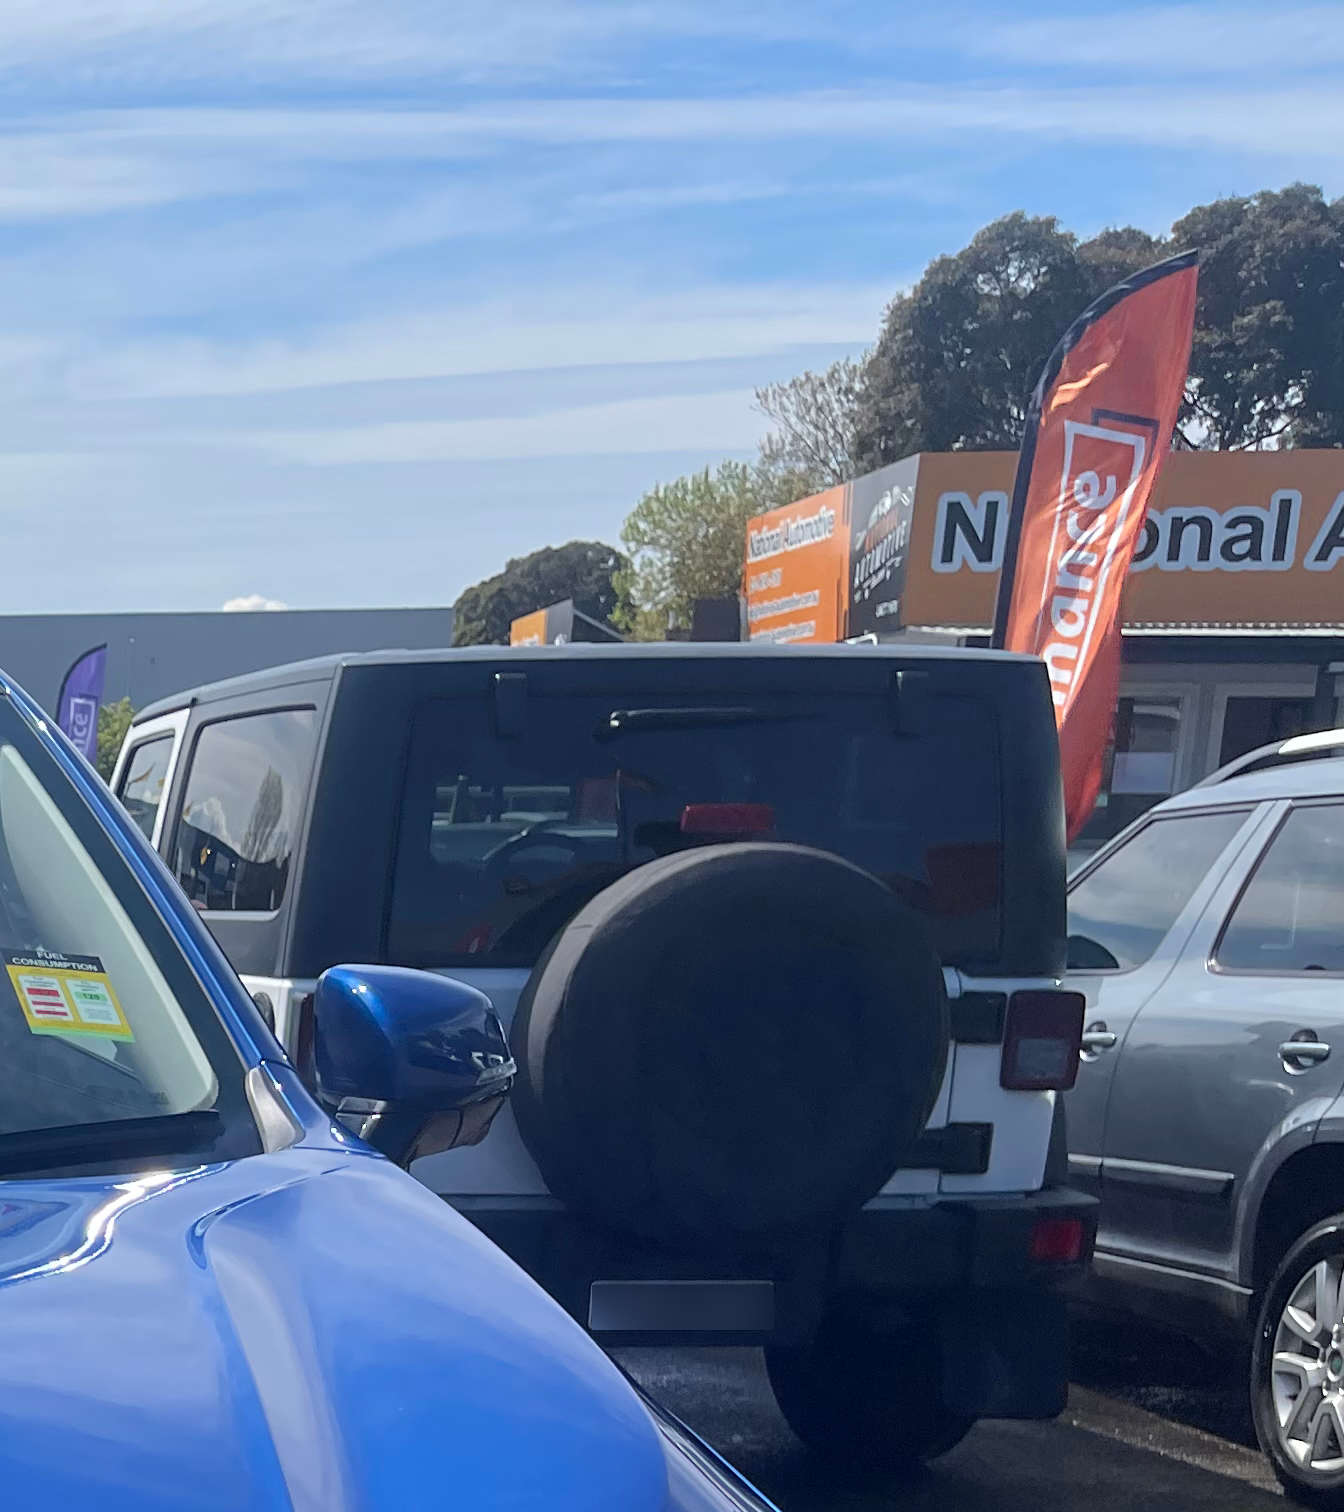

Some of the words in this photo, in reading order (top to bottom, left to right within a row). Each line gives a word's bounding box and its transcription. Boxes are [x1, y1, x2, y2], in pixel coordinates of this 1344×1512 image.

[936, 494, 1295, 567] Nonal
[1043, 470, 1117, 705] nance
[12, 957, 98, 972] CONSUMPTION
[36, 951, 68, 961] FUEL
